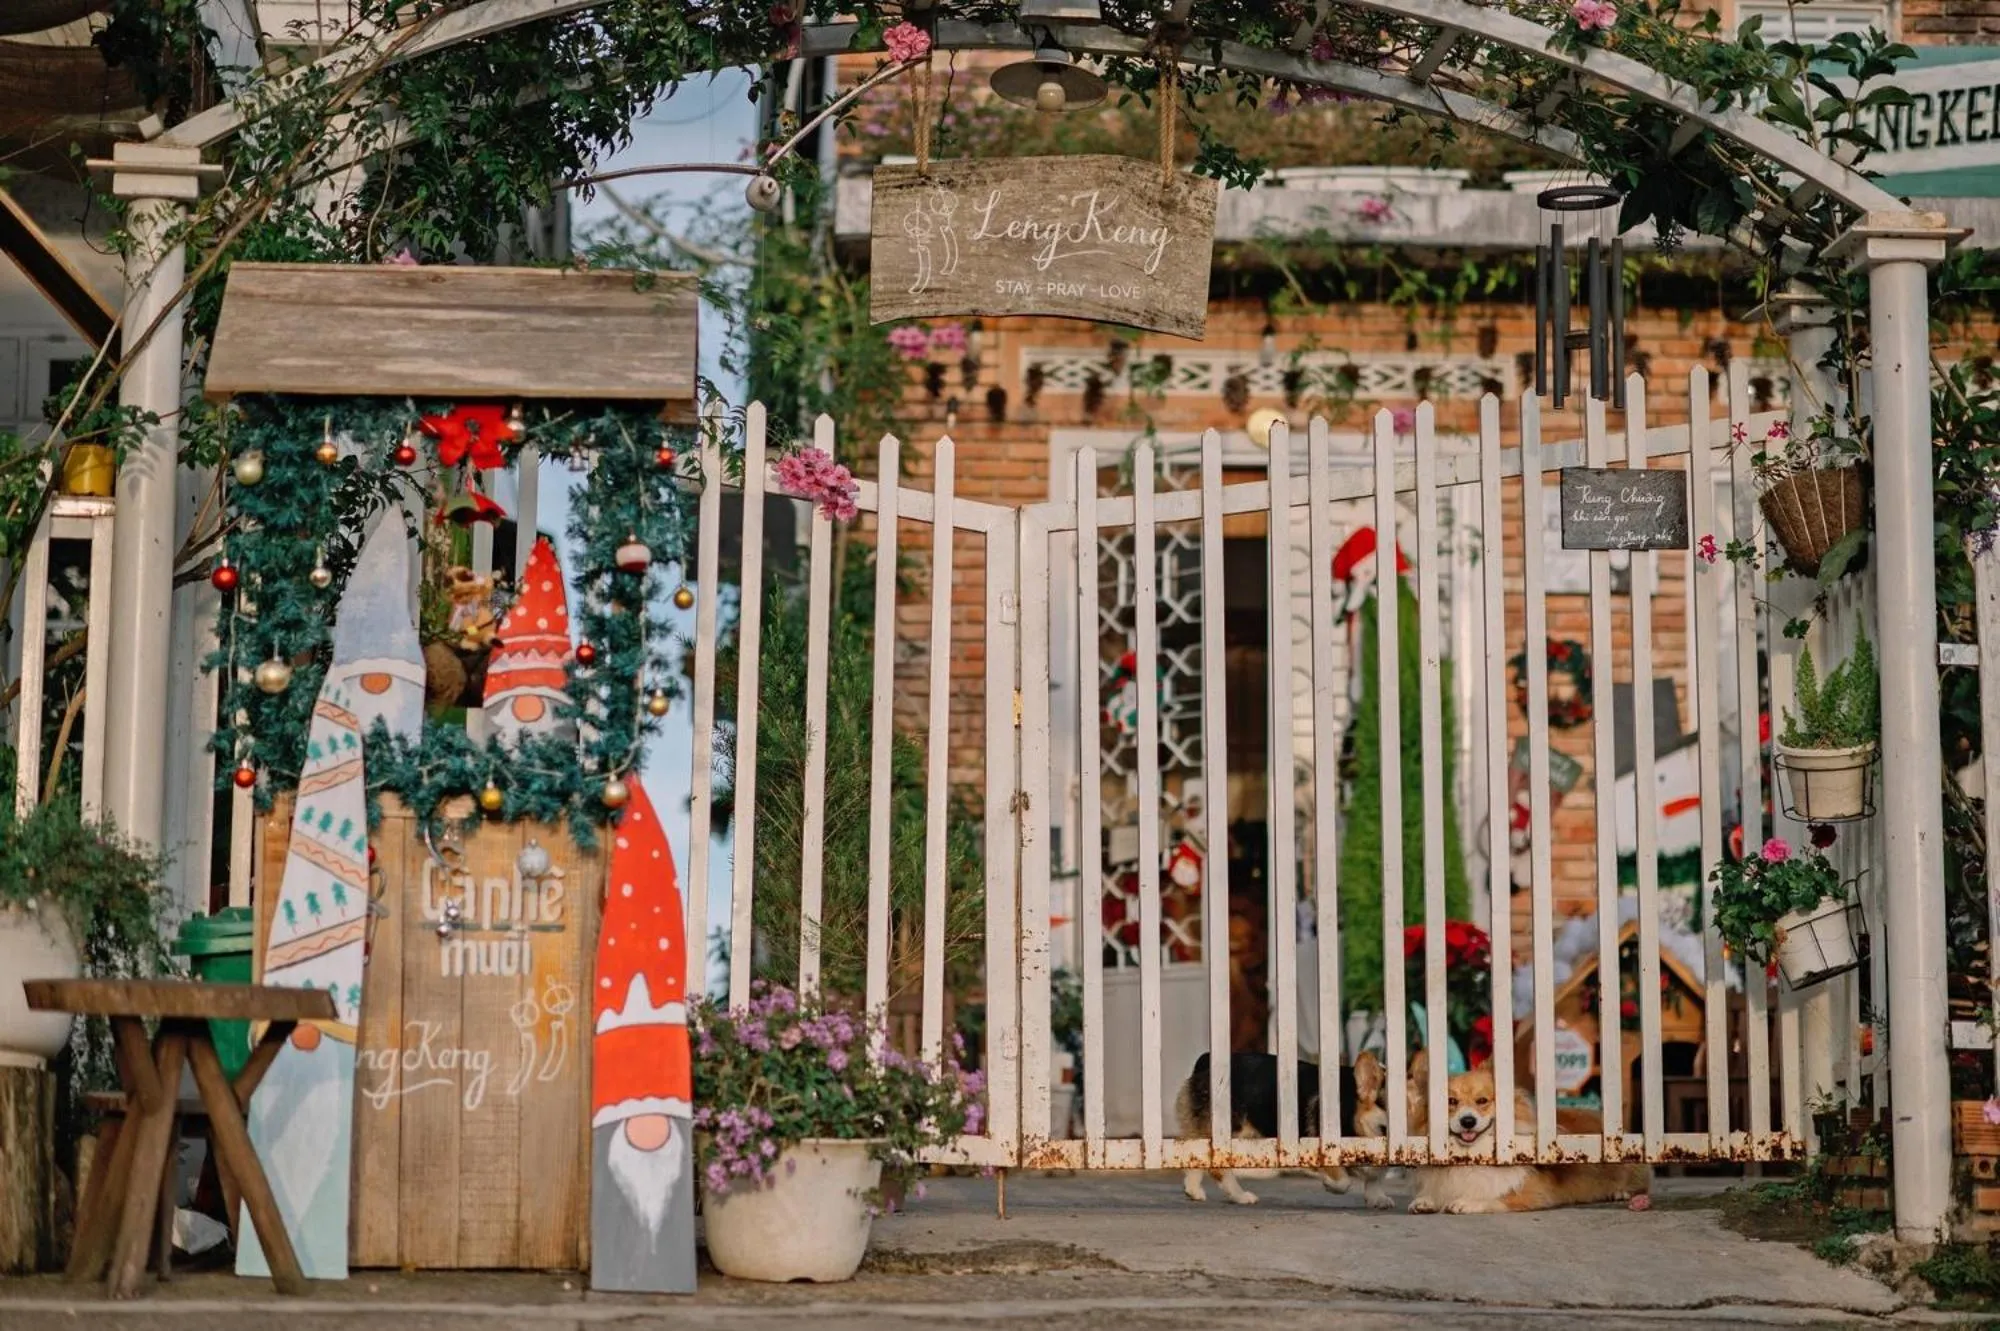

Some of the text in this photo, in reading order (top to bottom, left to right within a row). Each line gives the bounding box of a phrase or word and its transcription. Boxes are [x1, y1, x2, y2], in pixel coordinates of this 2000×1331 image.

[1829, 84, 2000, 155] ENGKE
[995, 279, 1031, 294] STAY
[1047, 282, 1086, 297] PRAY
[1100, 284, 1141, 299] LOVE
